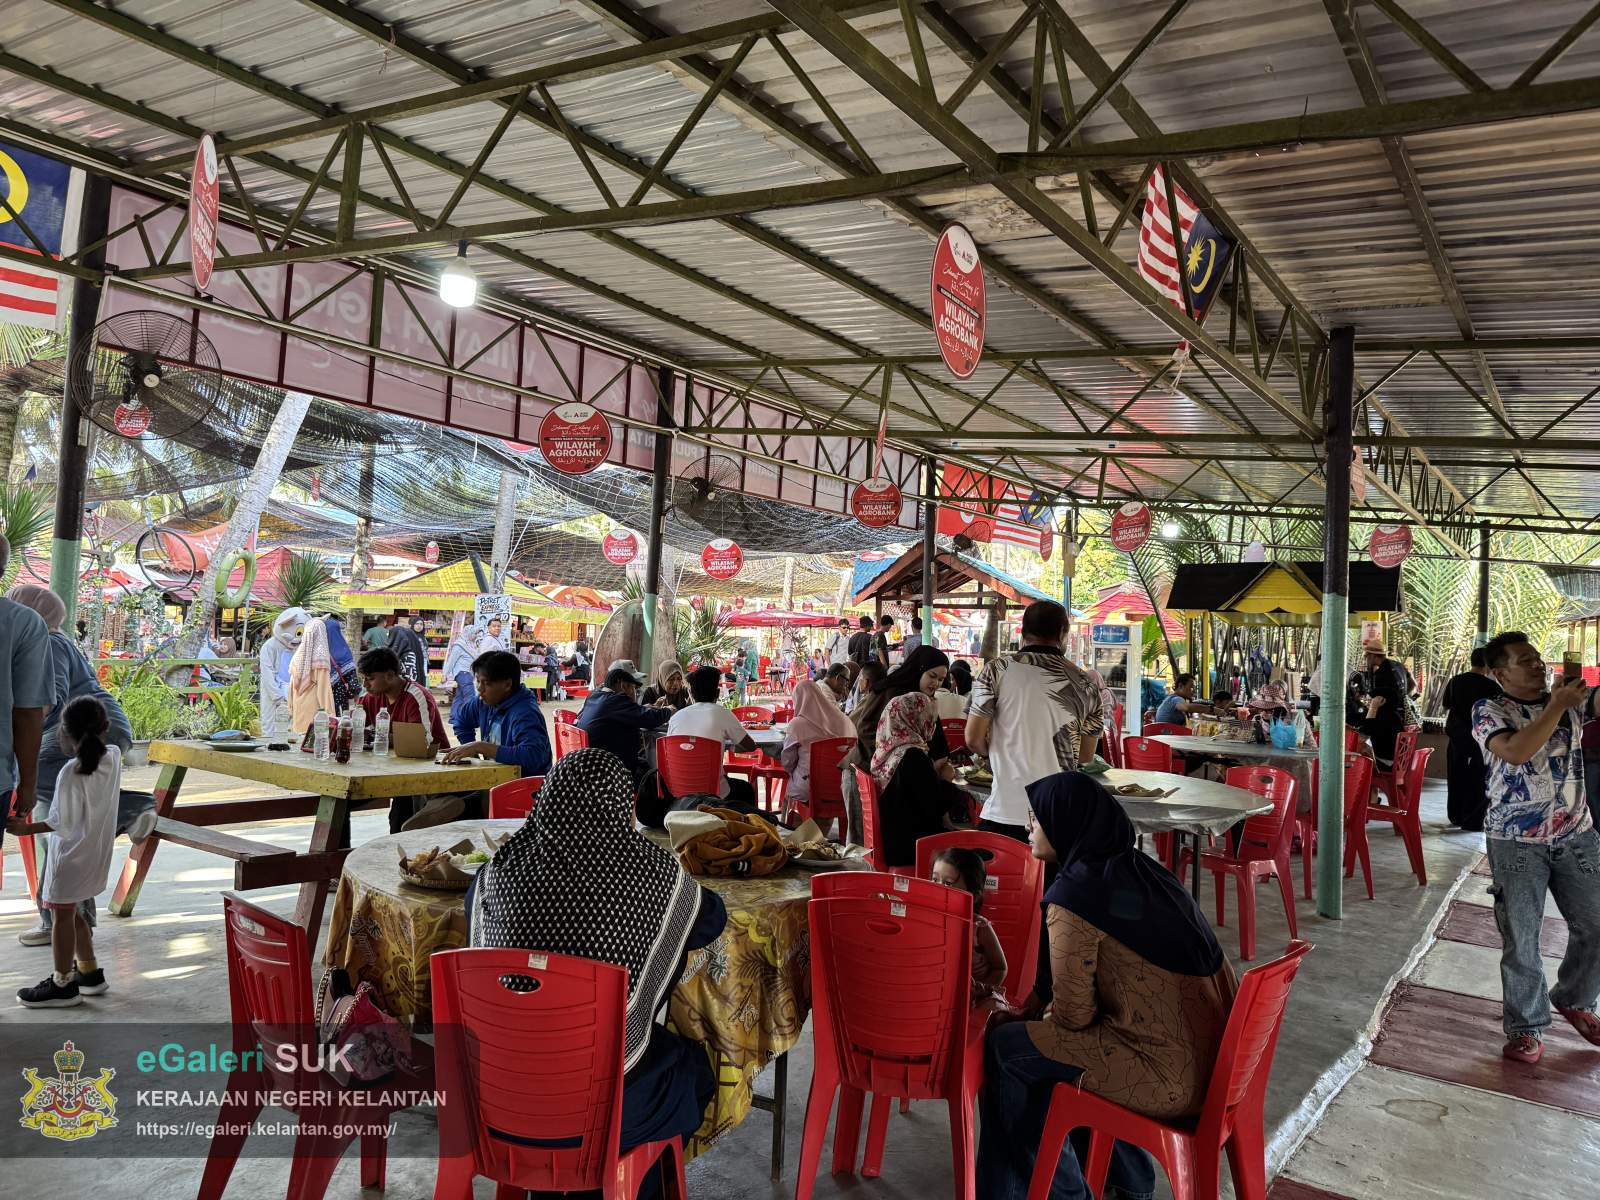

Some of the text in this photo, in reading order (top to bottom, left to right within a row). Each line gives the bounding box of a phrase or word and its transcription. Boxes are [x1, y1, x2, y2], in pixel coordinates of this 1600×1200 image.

[944, 299, 976, 334] WILAYAH
[938, 313, 979, 352] AGROBANK
[555, 441, 596, 449] WILAYAH
[549, 449, 602, 457] AGROBANK
[1118, 526, 1143, 536] WILAYAH
[1115, 531, 1146, 542] AGROBANK
[1377, 543, 1403, 552] WILAYAH
[1374, 548, 1407, 558] AGROBANK
